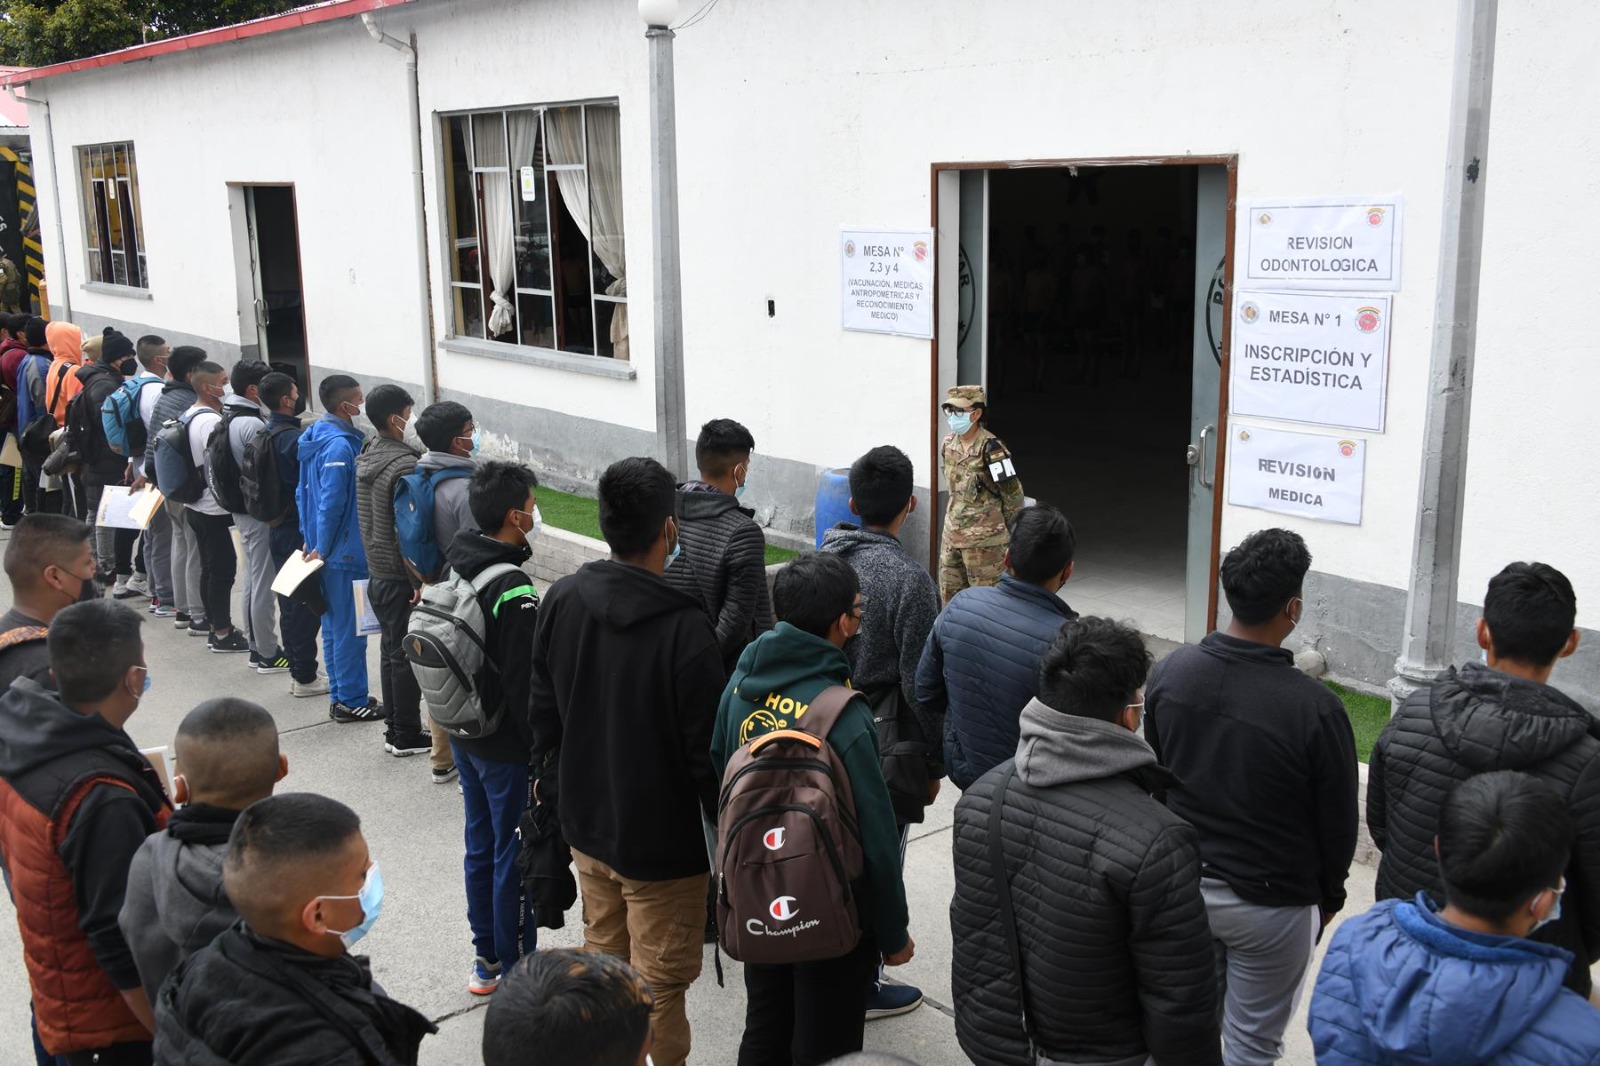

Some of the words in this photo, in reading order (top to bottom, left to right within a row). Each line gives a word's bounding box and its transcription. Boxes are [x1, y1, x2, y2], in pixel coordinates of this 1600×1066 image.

[1287, 236, 1353, 250] REVISION
[863, 245, 891, 257] MESA
[885, 264, 891, 276] y
[893, 262, 899, 273] 4
[1260, 258, 1379, 272] ODONTOLOGICA
[915, 293, 920, 301] Y
[856, 300, 913, 311] RECONOCIMIENTO
[1269, 310, 1310, 325] MESA
[1334, 313, 1341, 327] 1
[1245, 343, 1354, 367] INSCRIPCIÓN
[1360, 352, 1372, 368] Y
[1250, 366, 1363, 391] ESTADÍSTICA
[1269, 487, 1323, 506] MEDICA
[746, 918, 820, 938] Champion
